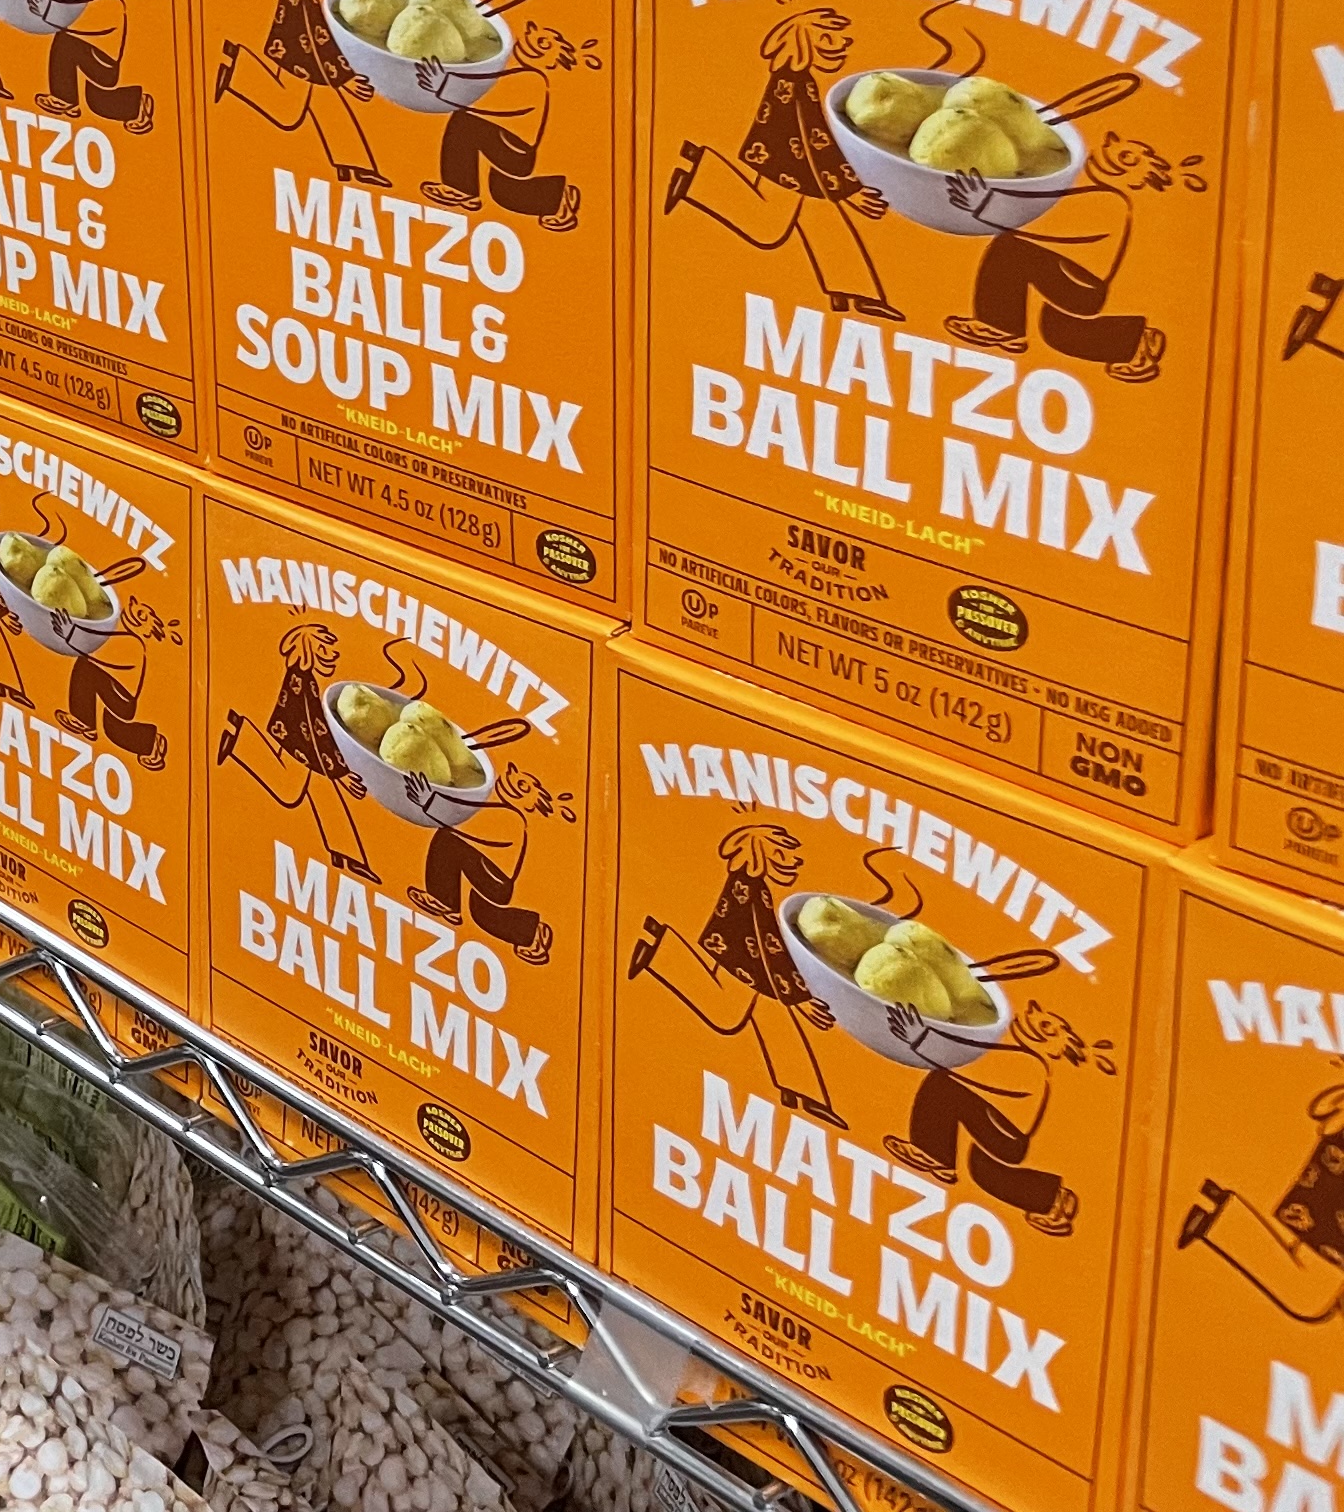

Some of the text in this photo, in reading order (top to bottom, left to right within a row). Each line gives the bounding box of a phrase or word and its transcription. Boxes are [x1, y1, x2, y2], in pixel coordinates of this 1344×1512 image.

[273, 168, 526, 293] MATZO
[292, 247, 508, 365] BALL &
[236, 304, 582, 473] SOUP MIX
[743, 292, 1092, 455] MATZO
[309, 457, 501, 548] NET WT 4.5 oz (128g)
[691, 364, 1156, 575] BALL MIX
[543, 546, 589, 572] PASSOVER
[768, 548, 888, 602] TRADITION
[787, 524, 865, 571] SAVOR
[812, 559, 840, 579] OUR
[220, 557, 571, 739] MANISCHEWITZ
[659, 548, 1027, 695] NO ARTIFICIAL COLORS, FLAVORS OR PRESERVATIVES
[777, 630, 1012, 744] NET WT 5 oz (142g)
[1070, 755, 1148, 797] GMO
[1076, 731, 1143, 772] NON
[273, 839, 507, 1014] MATZO
[238, 889, 551, 1120] BALL MIX
[104, 1315, 144, 1343] לפסח
[149, 1339, 176, 1360] כשר
